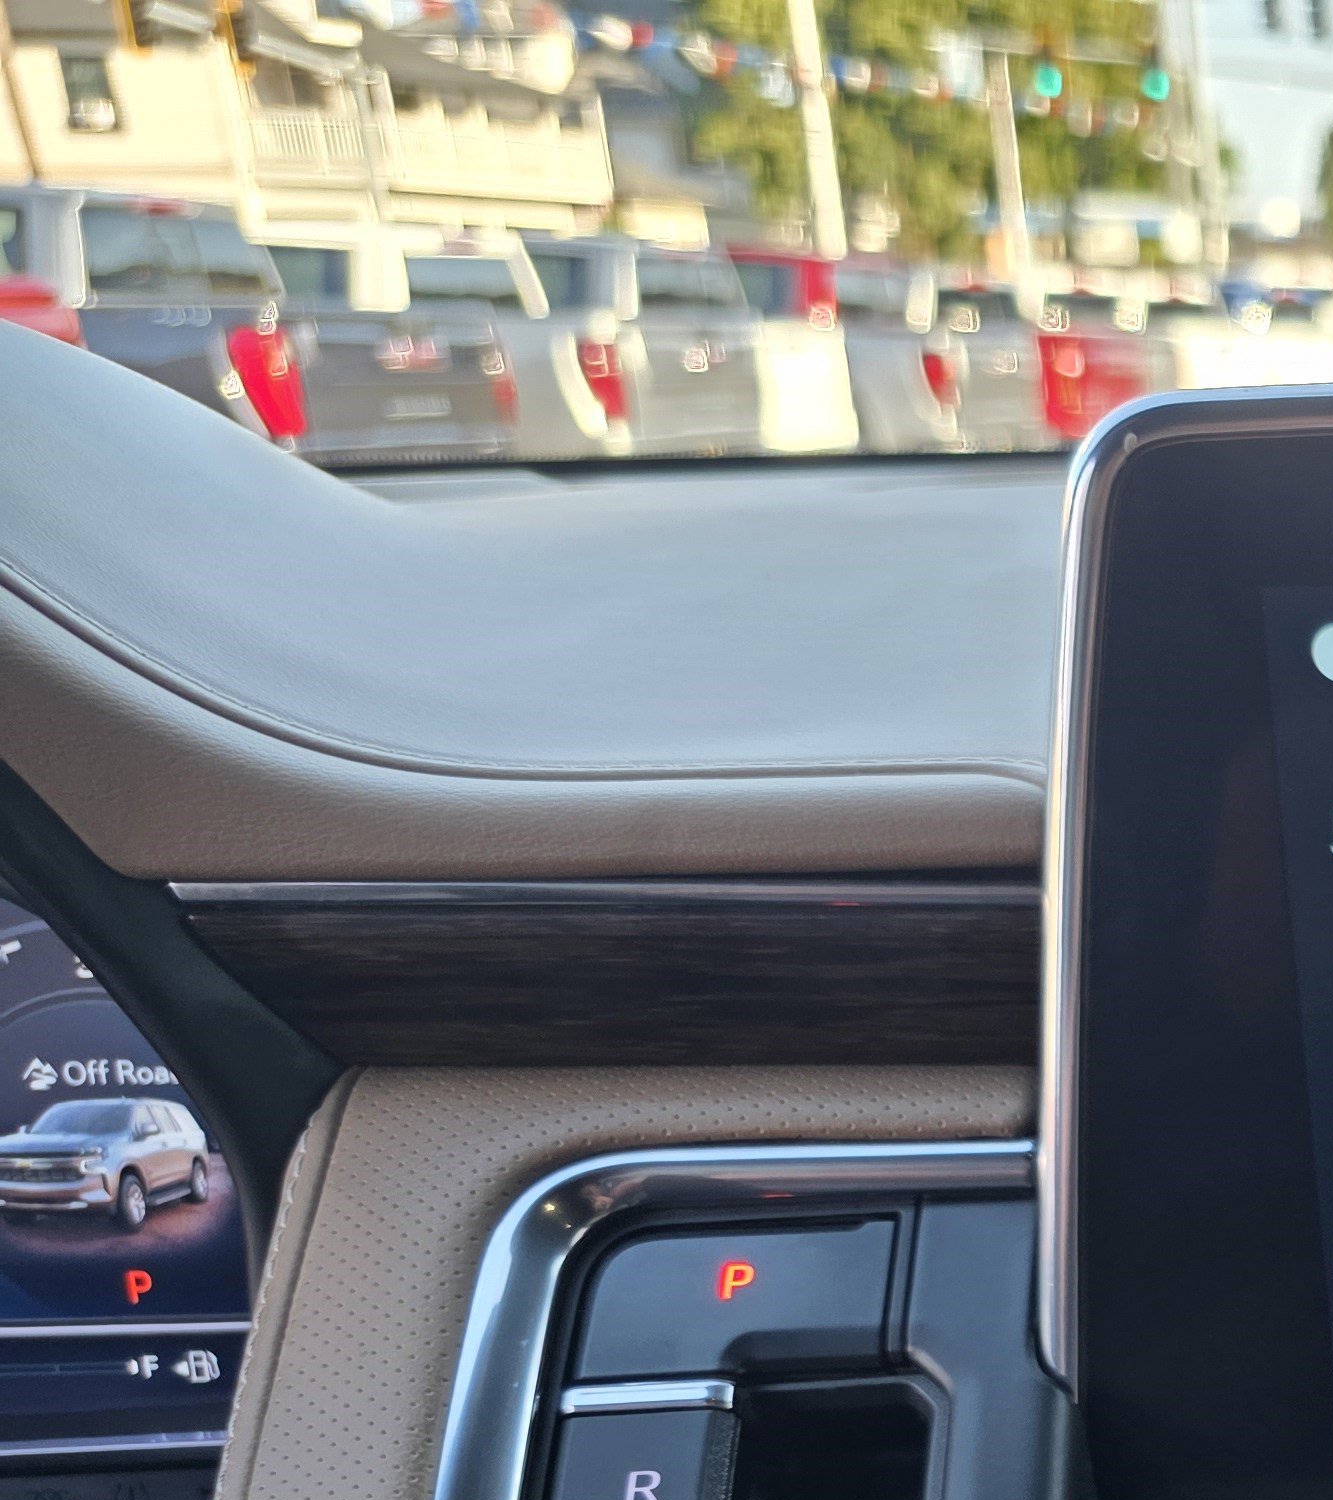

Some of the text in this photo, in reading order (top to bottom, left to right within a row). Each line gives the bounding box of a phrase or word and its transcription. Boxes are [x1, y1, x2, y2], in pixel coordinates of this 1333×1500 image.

[61, 1059, 109, 1086] Off
[125, 1270, 153, 1304] P
[716, 1260, 756, 1301] P
[139, 1354, 160, 1380] F
